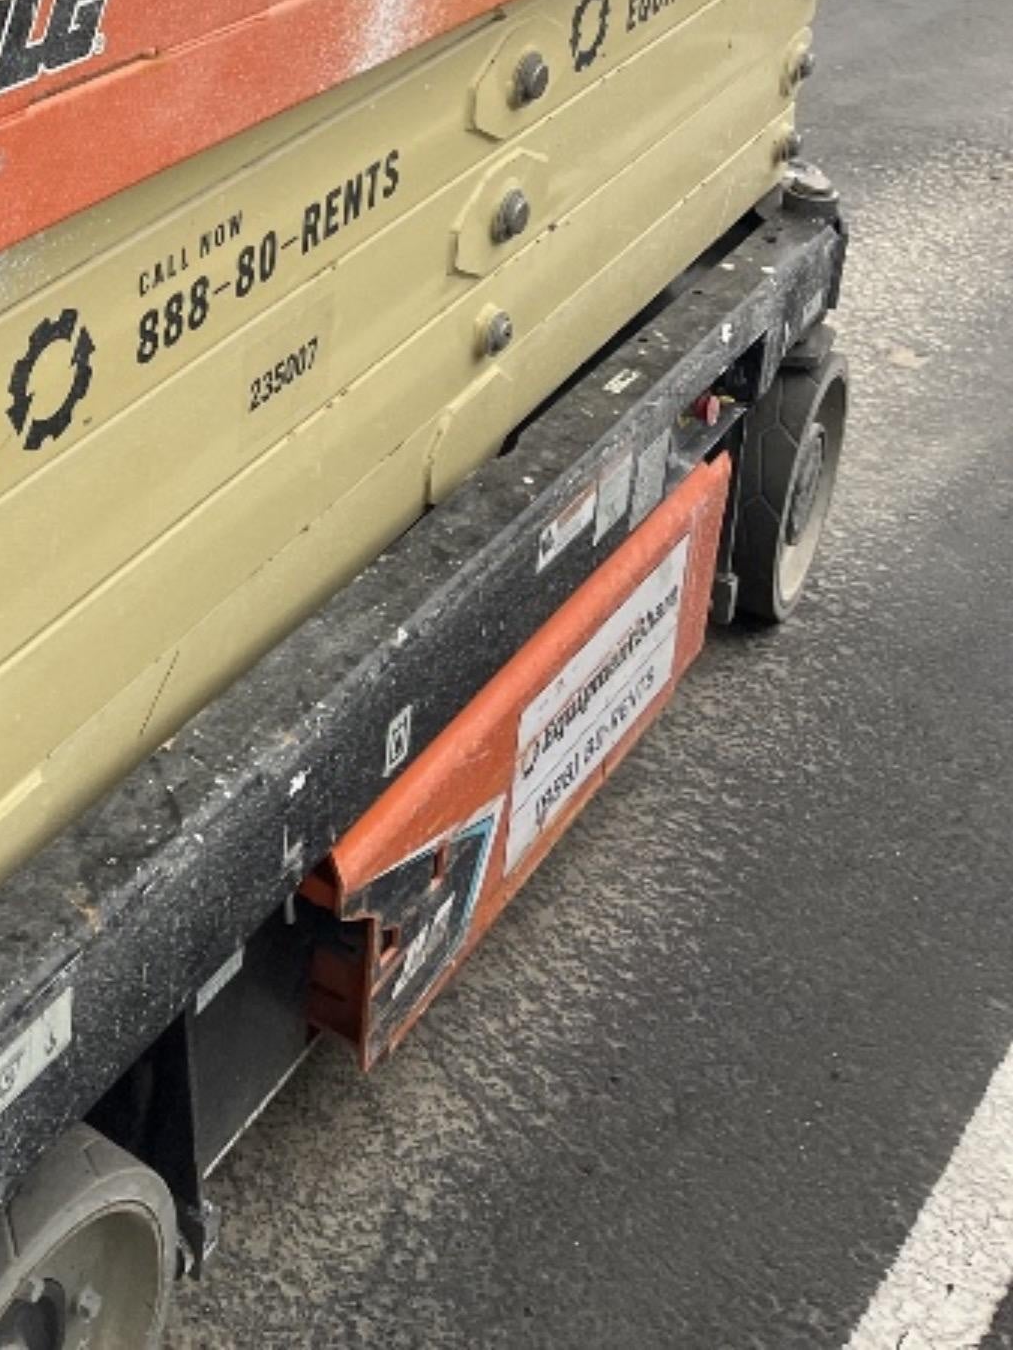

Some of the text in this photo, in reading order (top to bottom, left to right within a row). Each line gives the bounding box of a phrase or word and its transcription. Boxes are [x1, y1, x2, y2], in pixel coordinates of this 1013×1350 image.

[136, 149, 401, 364] 888-80-RENTS
[138, 210, 244, 298] CALL NOW
[248, 337, 319, 412] 235007
